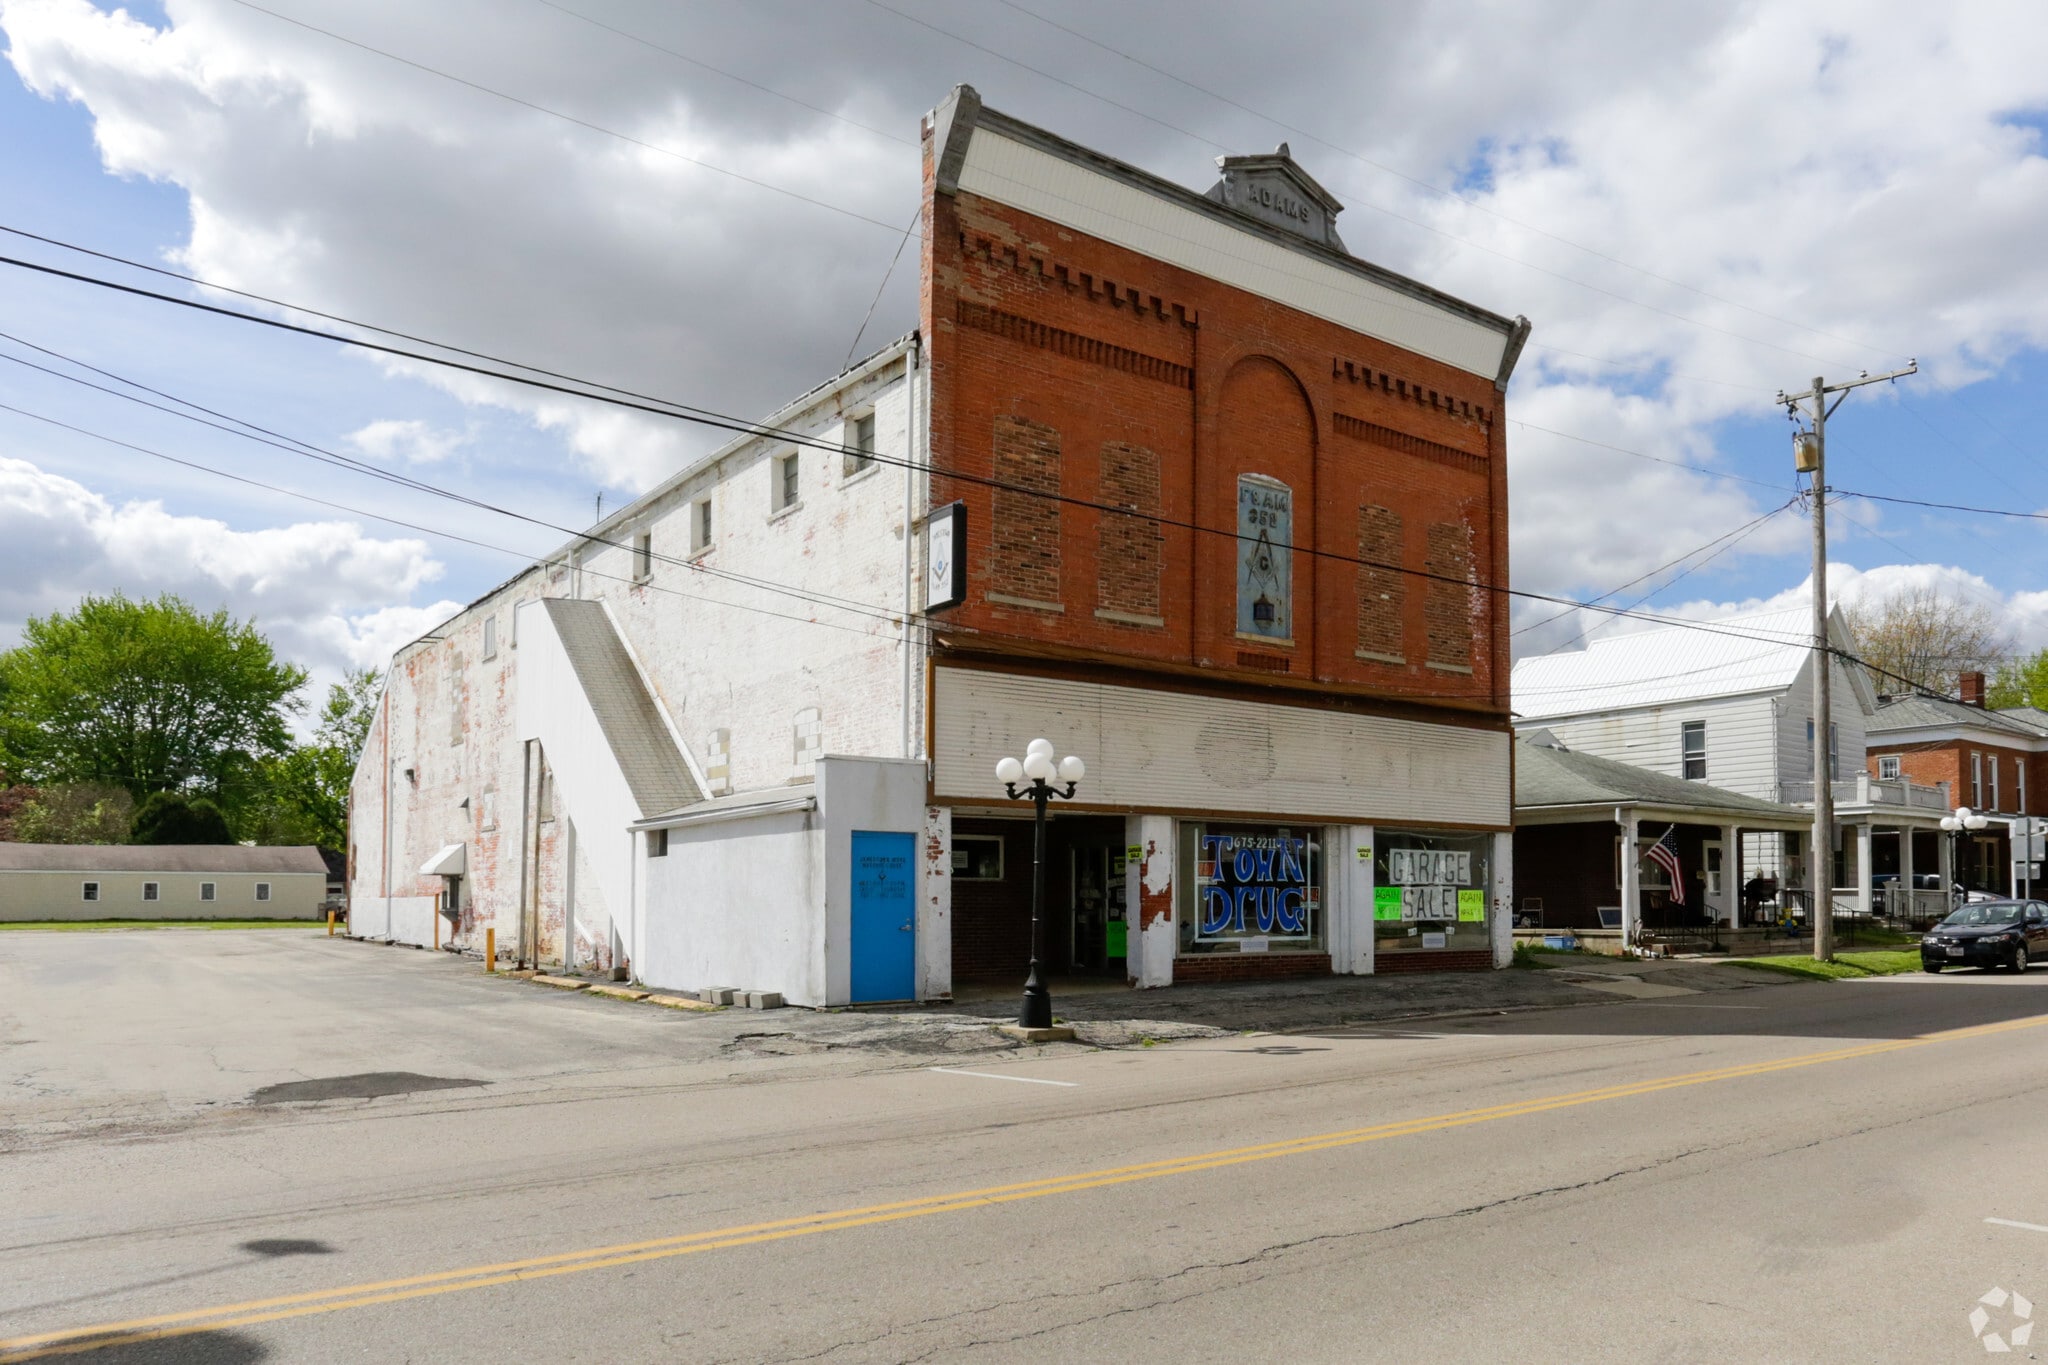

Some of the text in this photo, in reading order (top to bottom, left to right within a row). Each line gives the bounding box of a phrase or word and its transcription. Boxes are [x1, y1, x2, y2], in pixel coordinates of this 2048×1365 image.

[1248, 183, 1310, 223] ADAMS
[1233, 836, 1278, 849] 675-2211
[1202, 835, 1305, 883] TOWN
[1393, 851, 1468, 883] GARAGE
[1375, 889, 1400, 900] AGAIN
[1403, 888, 1453, 918] SALE
[1460, 891, 1482, 904] AGAIN
